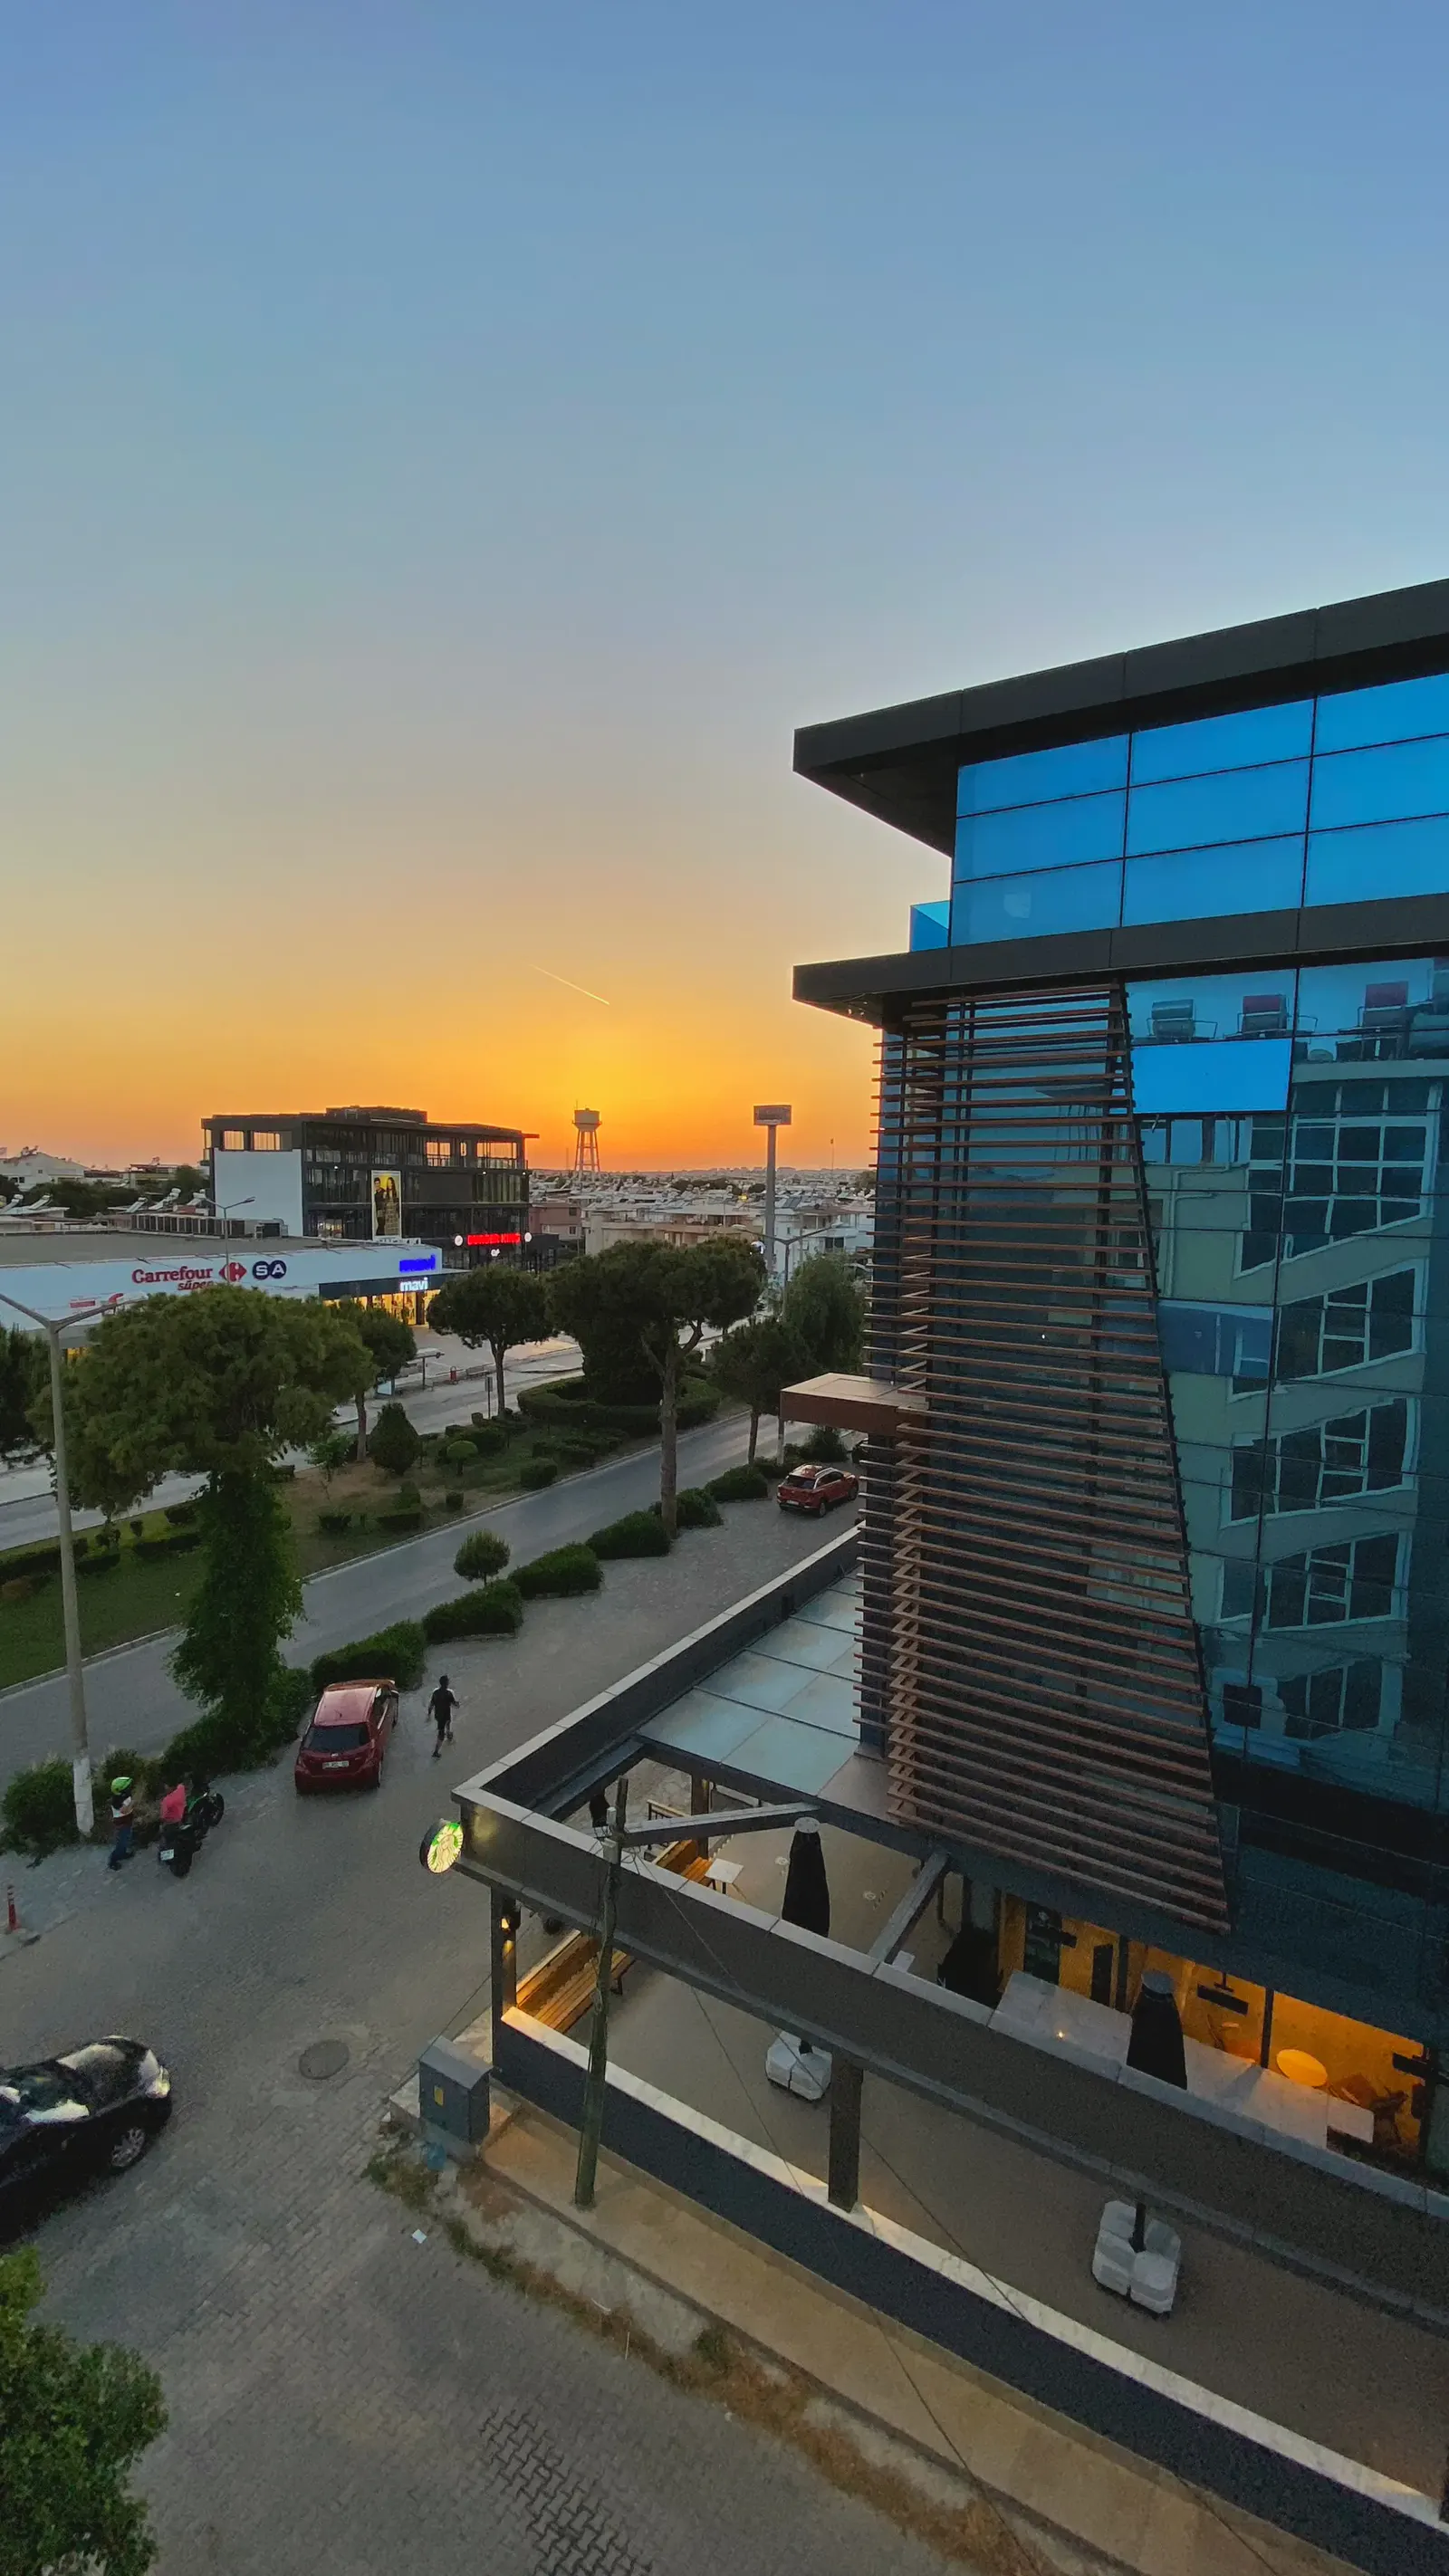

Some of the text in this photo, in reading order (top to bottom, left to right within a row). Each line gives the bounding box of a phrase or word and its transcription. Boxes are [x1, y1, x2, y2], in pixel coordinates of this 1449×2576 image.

[131, 1263, 285, 1283] Carrefour SA
[399, 1277, 428, 1292] mavi
